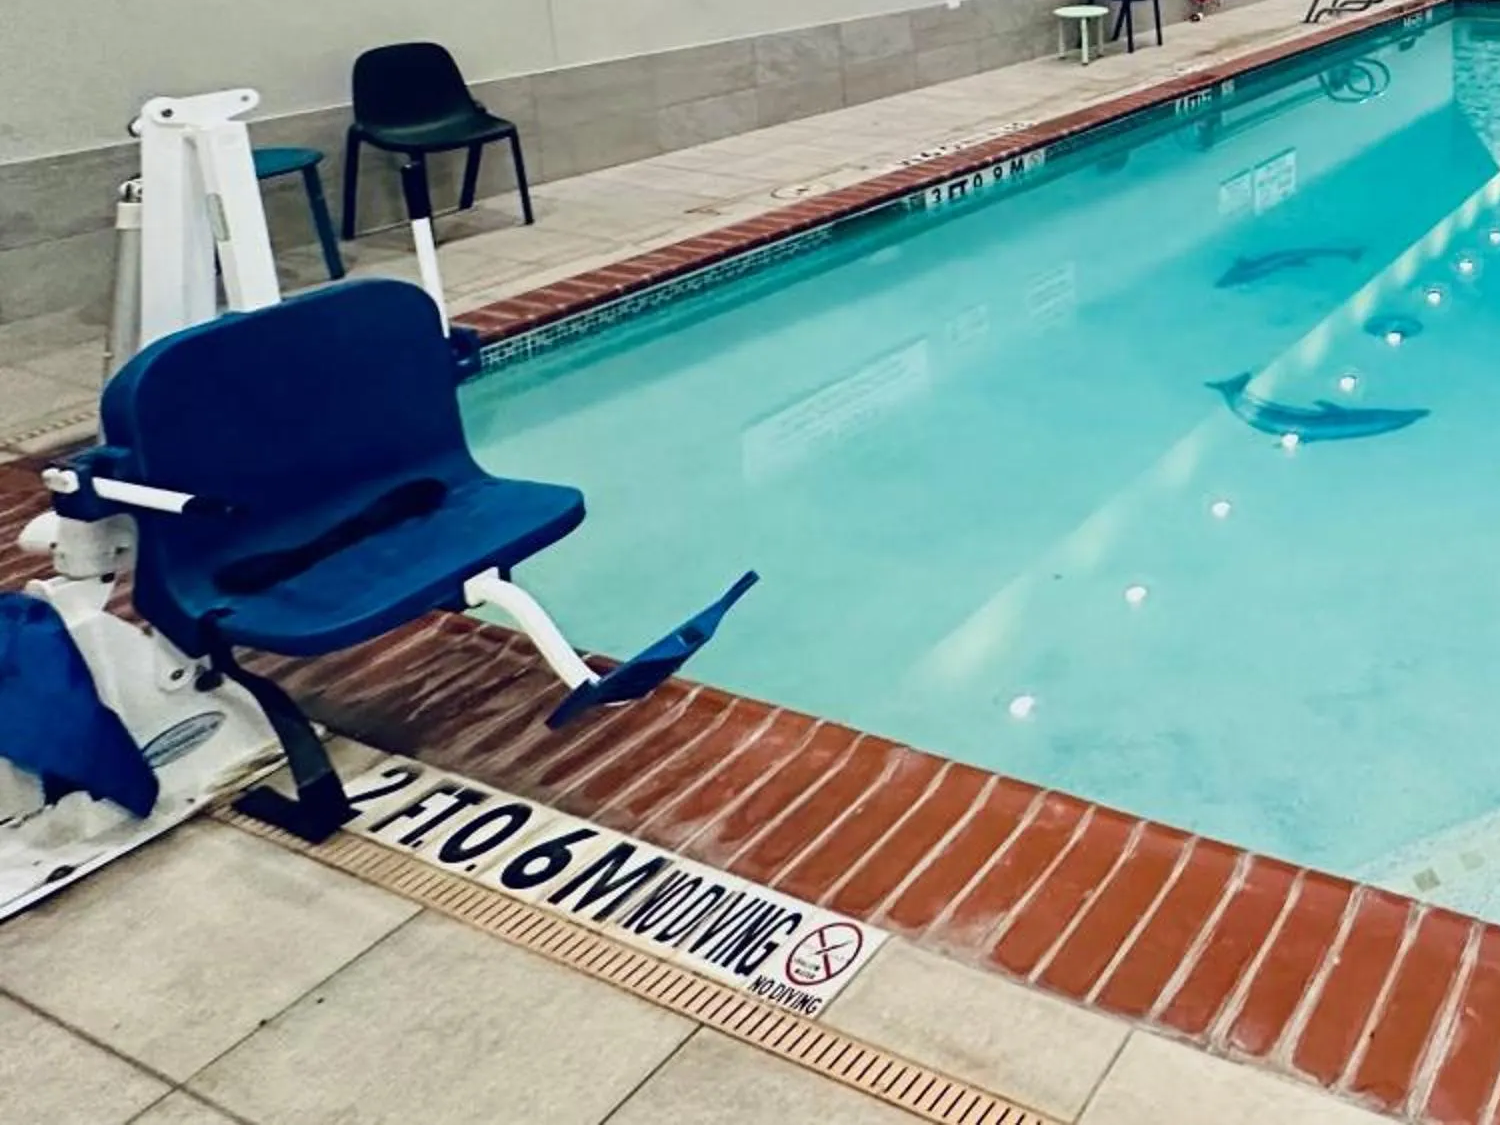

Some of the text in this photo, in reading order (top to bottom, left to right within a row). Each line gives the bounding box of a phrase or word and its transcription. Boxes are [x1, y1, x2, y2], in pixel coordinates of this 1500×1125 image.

[345, 763, 424, 819] 2
[547, 841, 674, 922] M
[747, 975, 822, 1015] NO DIVING
